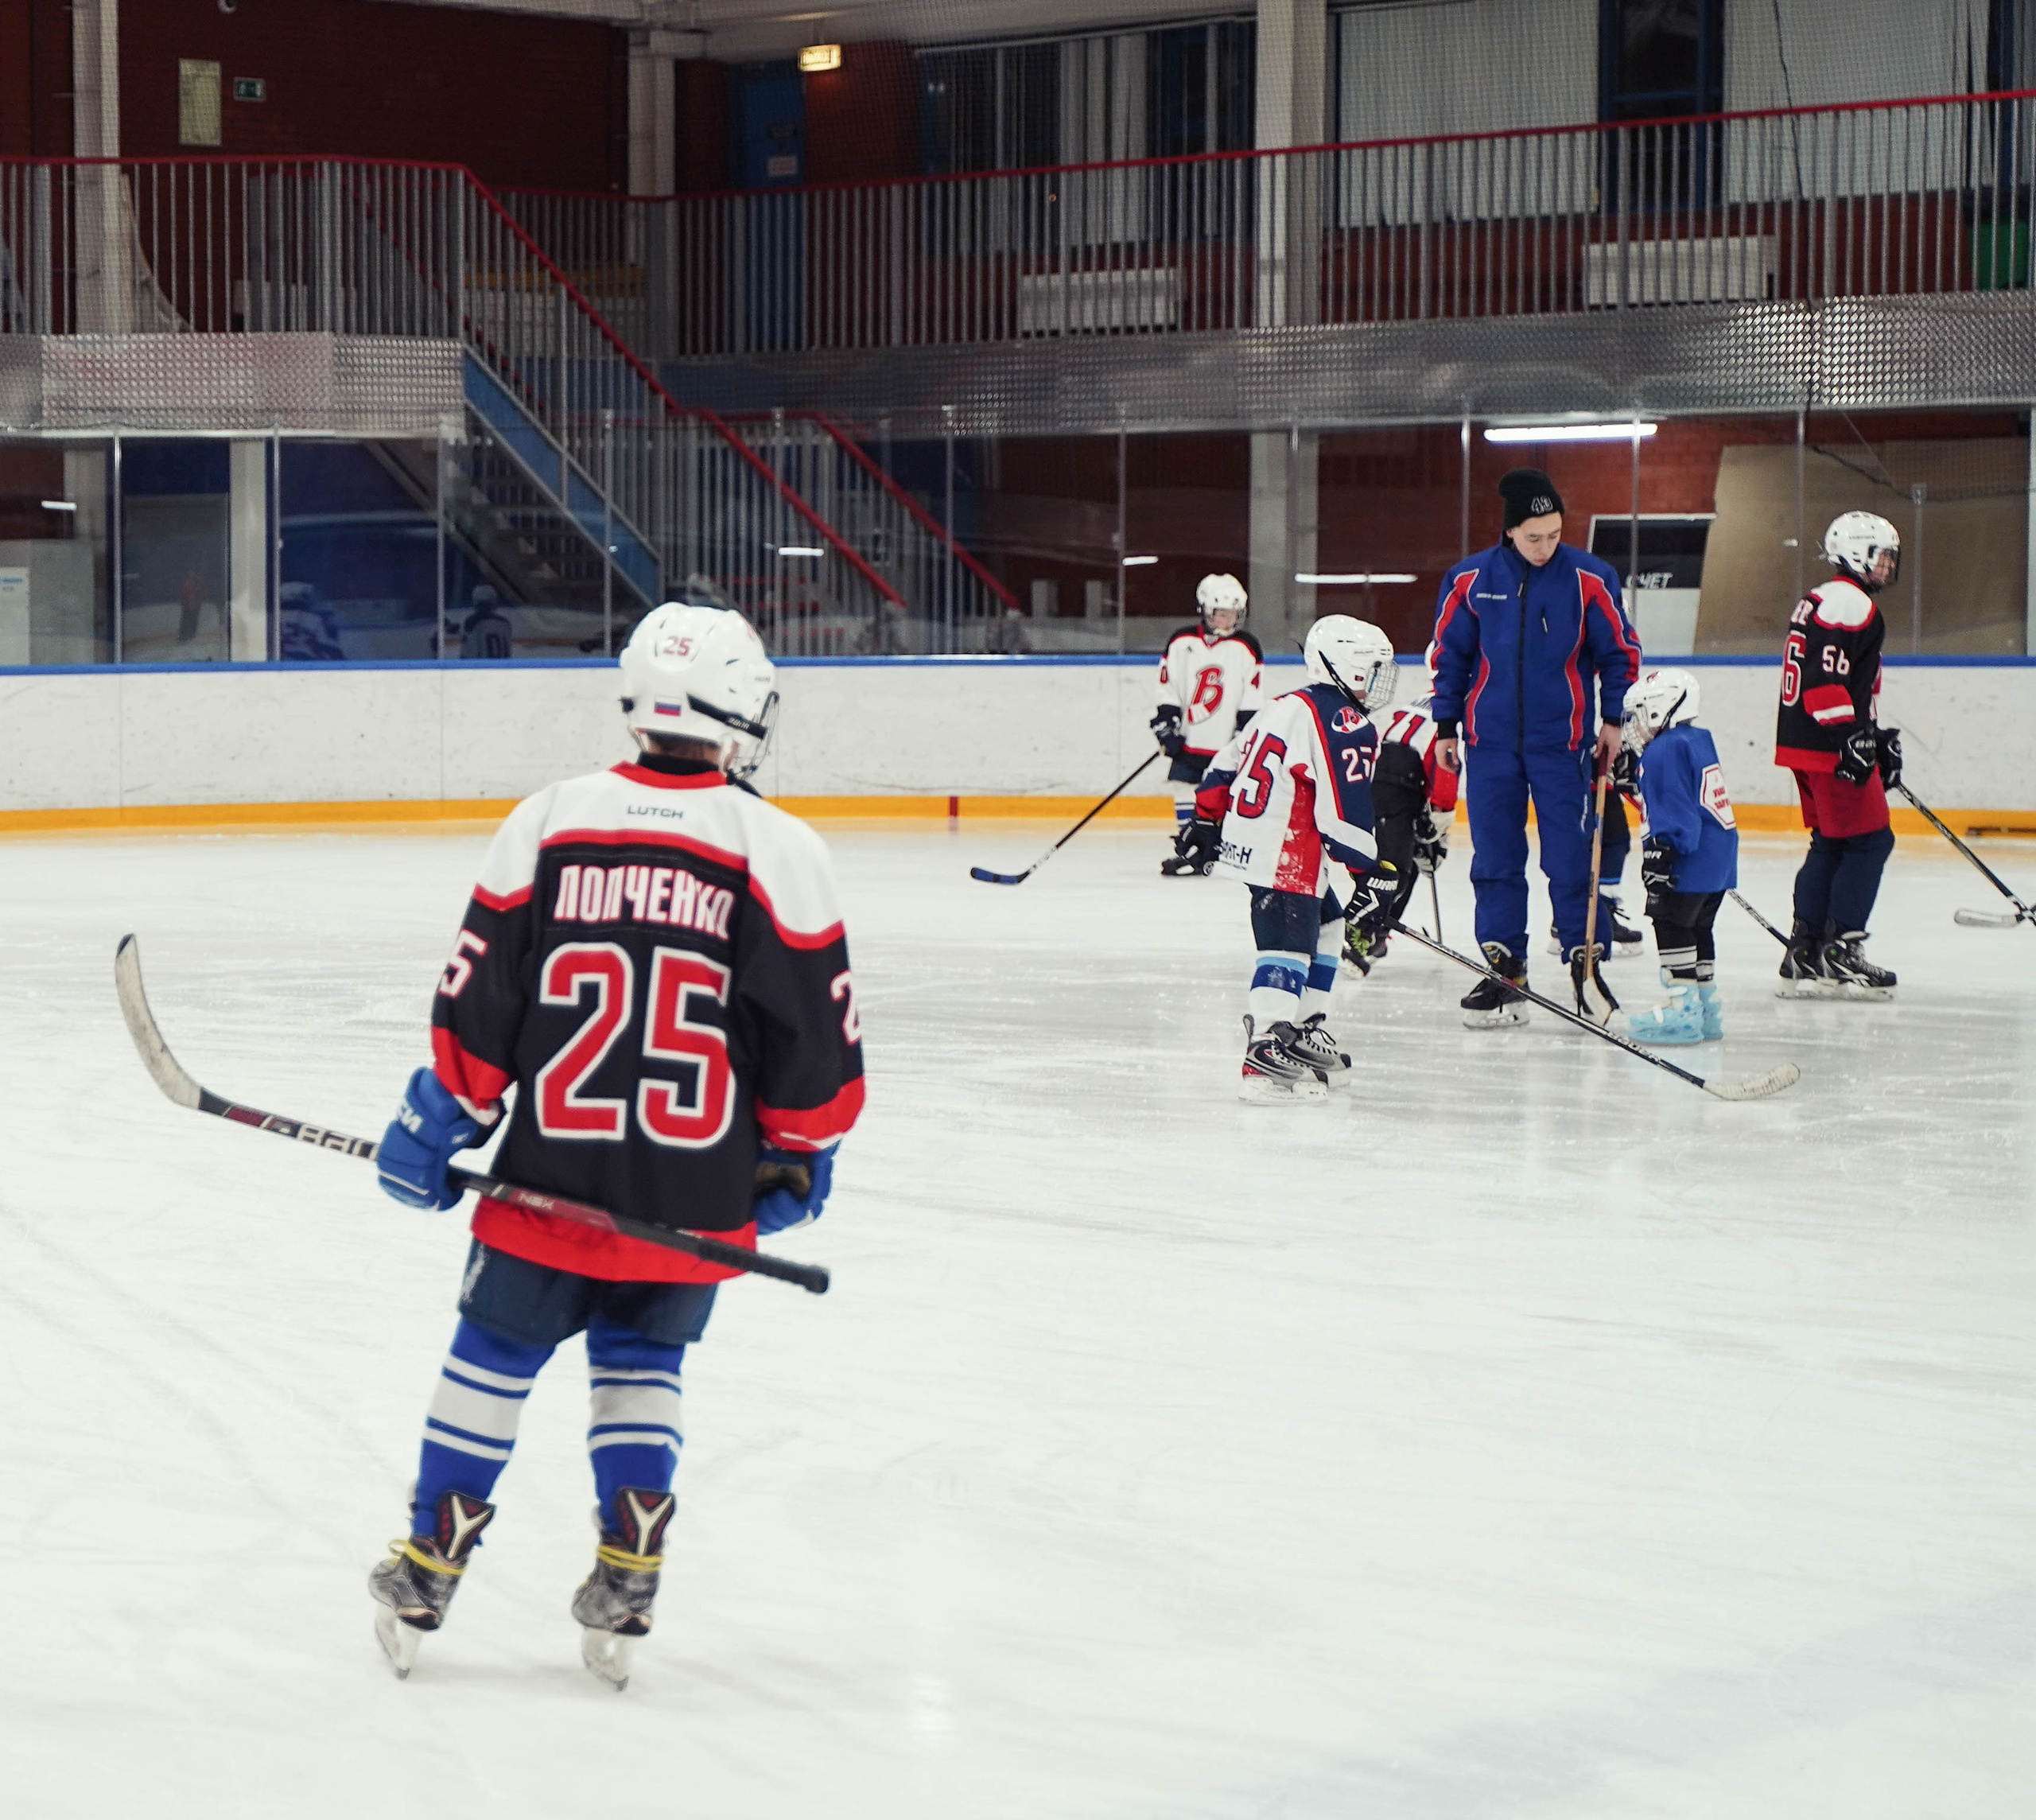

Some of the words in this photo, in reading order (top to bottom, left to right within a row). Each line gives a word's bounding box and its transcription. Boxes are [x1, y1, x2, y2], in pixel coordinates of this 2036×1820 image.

[662, 635, 694, 657] 25
[1822, 644, 1851, 676] 56
[627, 805, 684, 819] LUTCH
[535, 942, 736, 1149] 25
